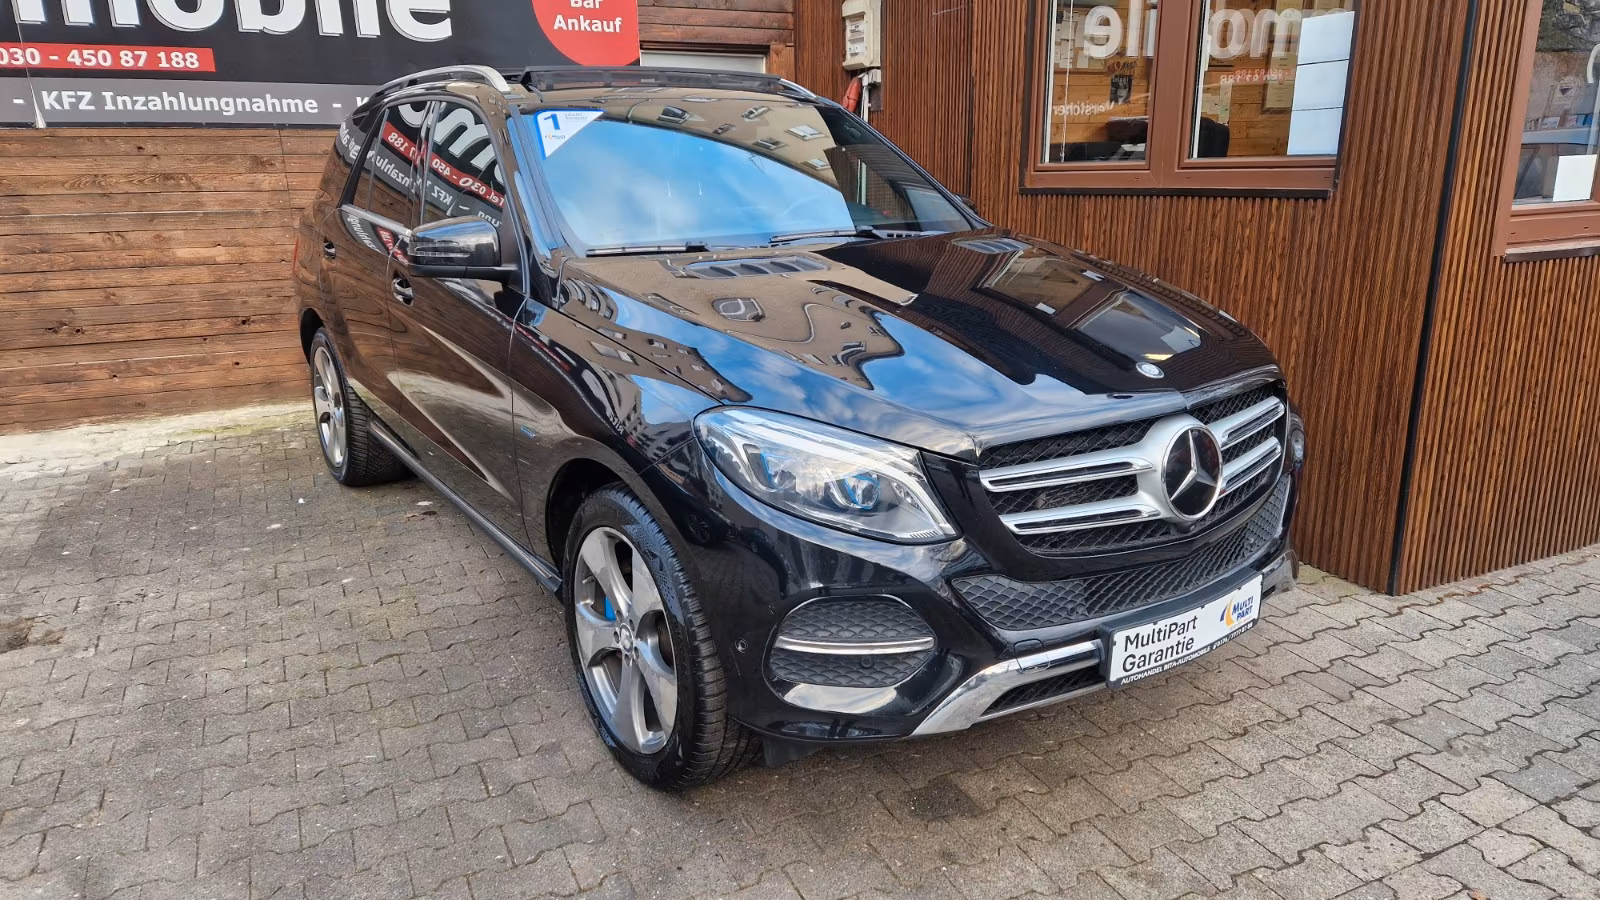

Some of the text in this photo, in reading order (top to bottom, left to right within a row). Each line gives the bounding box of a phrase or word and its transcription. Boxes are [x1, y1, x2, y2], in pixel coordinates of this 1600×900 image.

[553, 14, 622, 33] Ankauf
[67, 49, 112, 67] 450
[120, 50, 147, 67] 87
[157, 51, 199, 69] 188
[41, 91, 95, 110] KFZ
[102, 91, 319, 116] Inzahlungnahme
[543, 113, 560, 130] 1
[1232, 596, 1253, 615] MULTI
[1237, 605, 1253, 621] PART
[1124, 615, 1198, 652] MultiPart
[1122, 637, 1194, 673] Garantie
[1121, 665, 1163, 685] AUTOHANDEL
